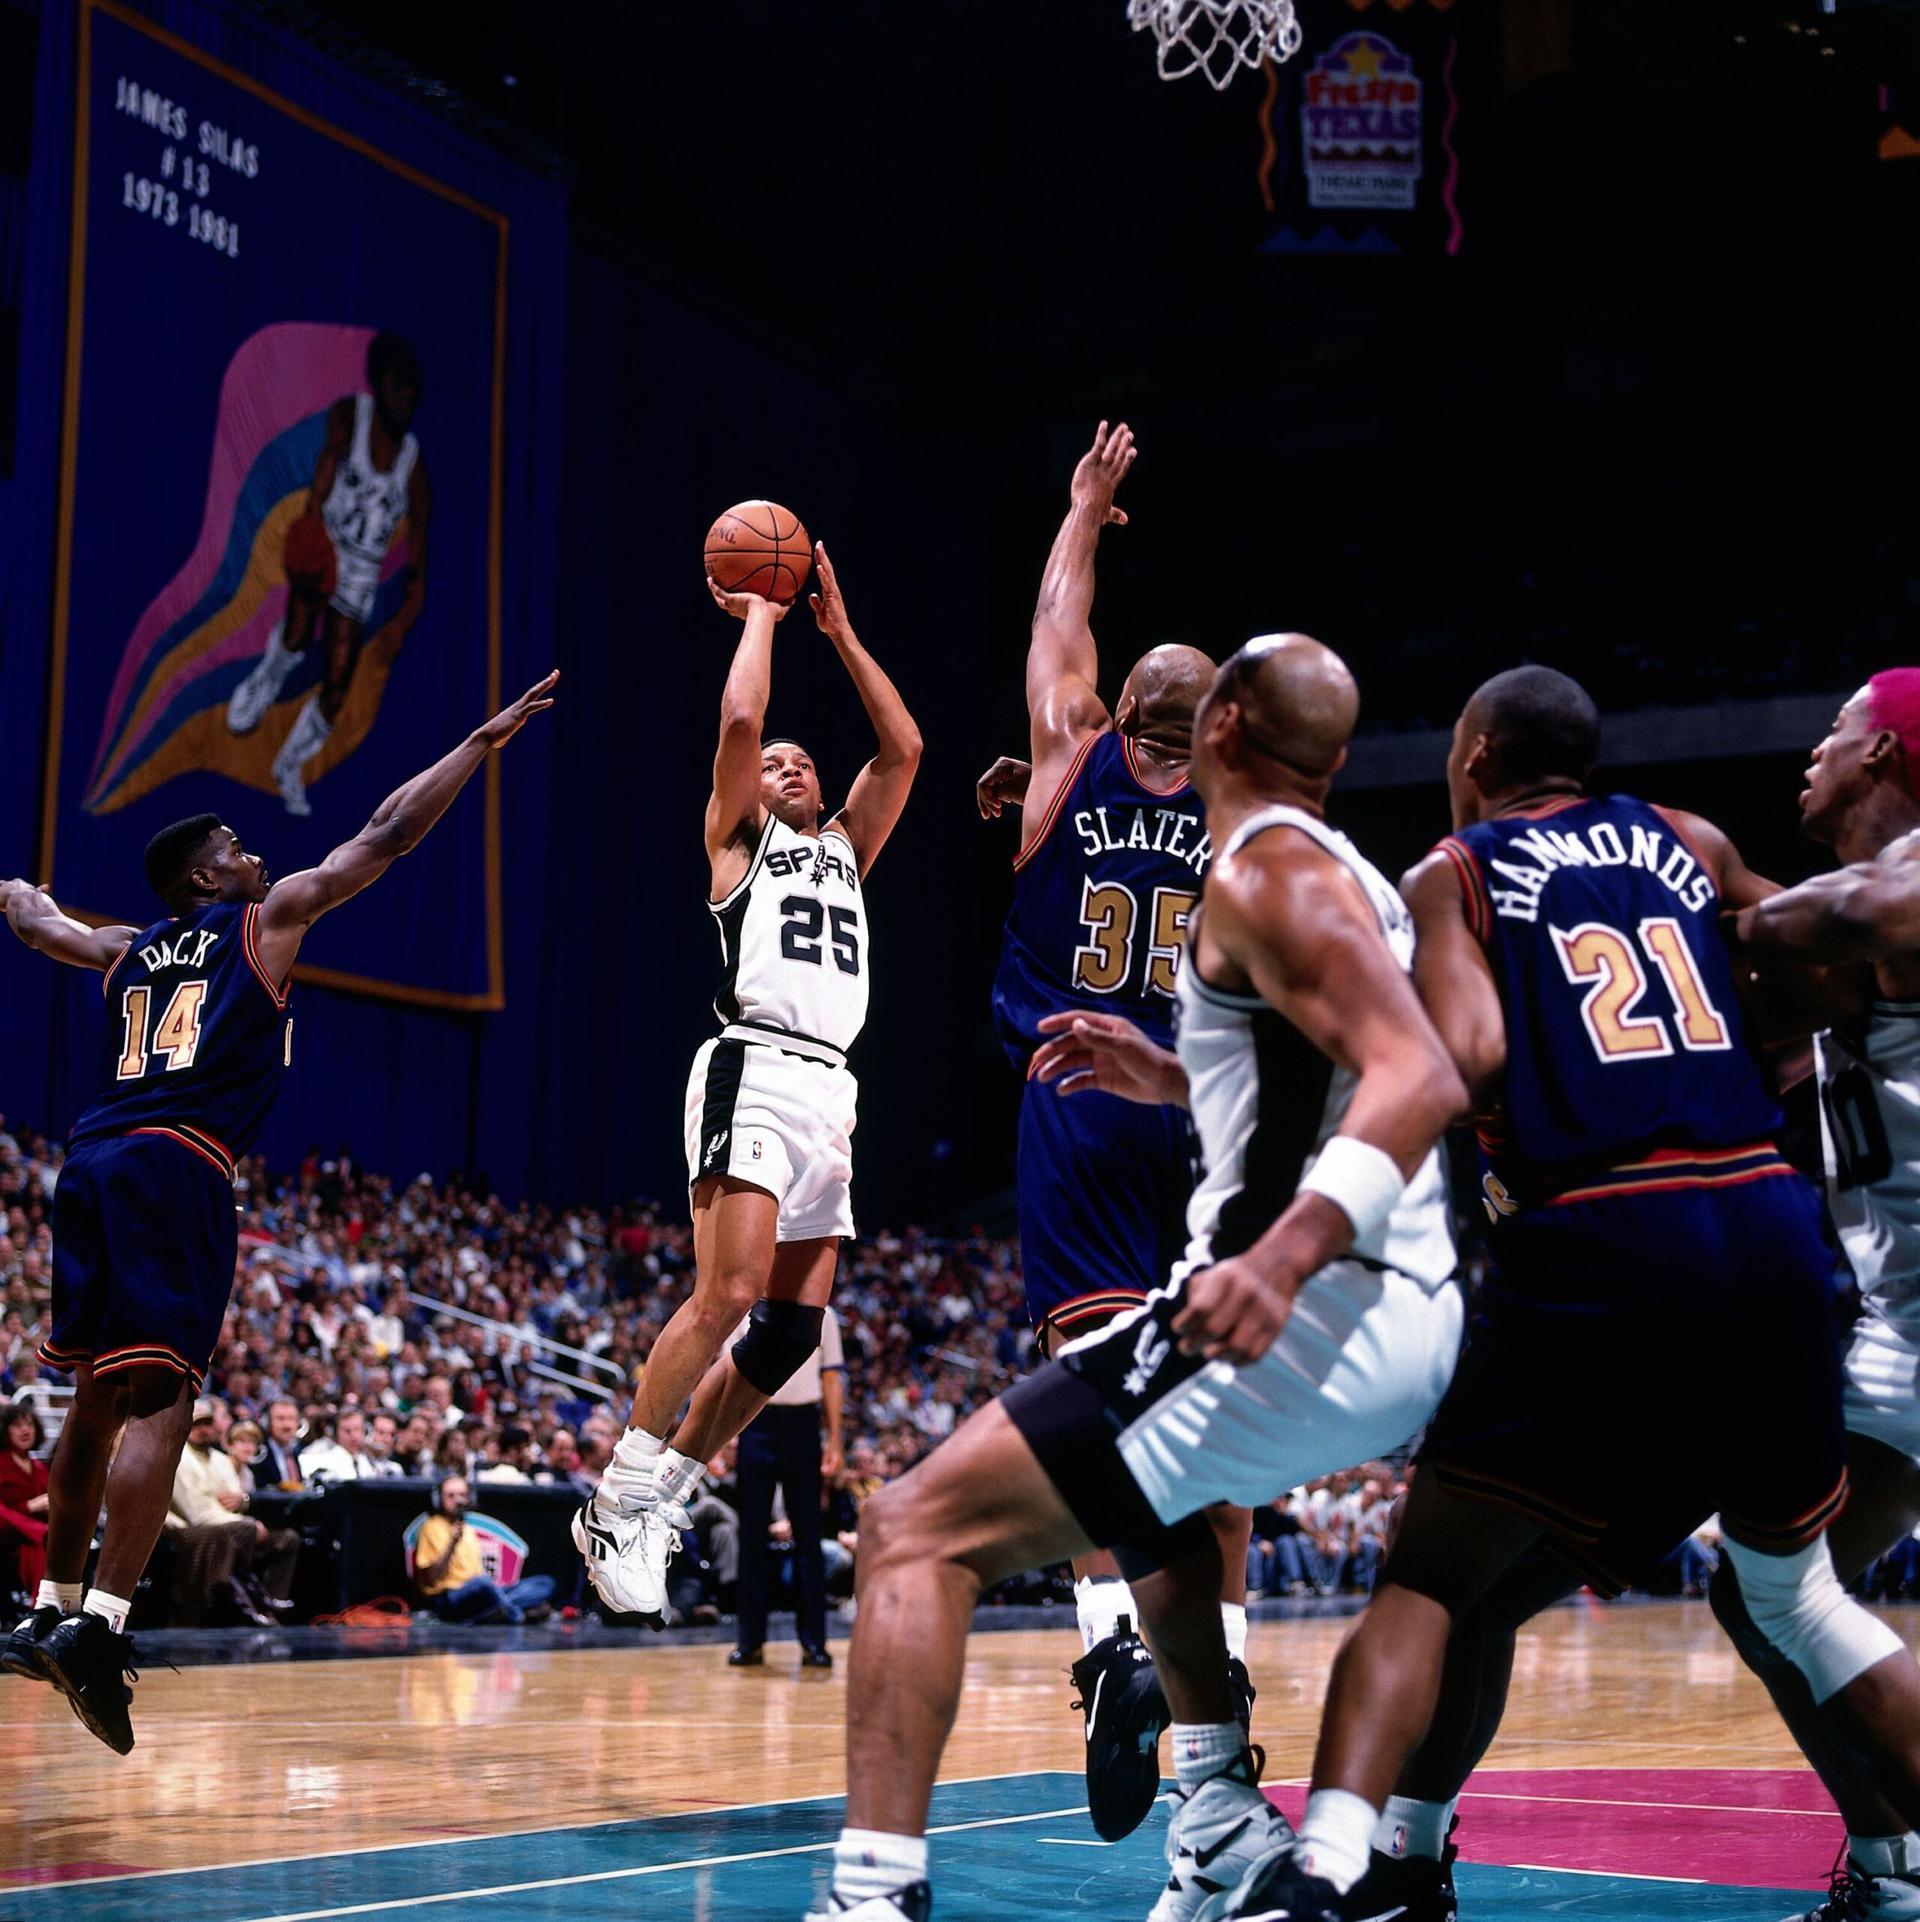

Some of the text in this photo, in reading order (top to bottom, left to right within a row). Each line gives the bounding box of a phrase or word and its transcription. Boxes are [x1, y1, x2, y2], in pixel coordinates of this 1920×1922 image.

[115, 75, 259, 179] JAMES SILAS
[1307, 108, 1417, 141] TEXAS
[1489, 822, 1715, 923] HAMMONDS
[780, 893, 860, 977] 25
[1072, 873, 1198, 999] 35
[117, 979, 208, 1081] 14
[1548, 917, 1734, 1065] 21
